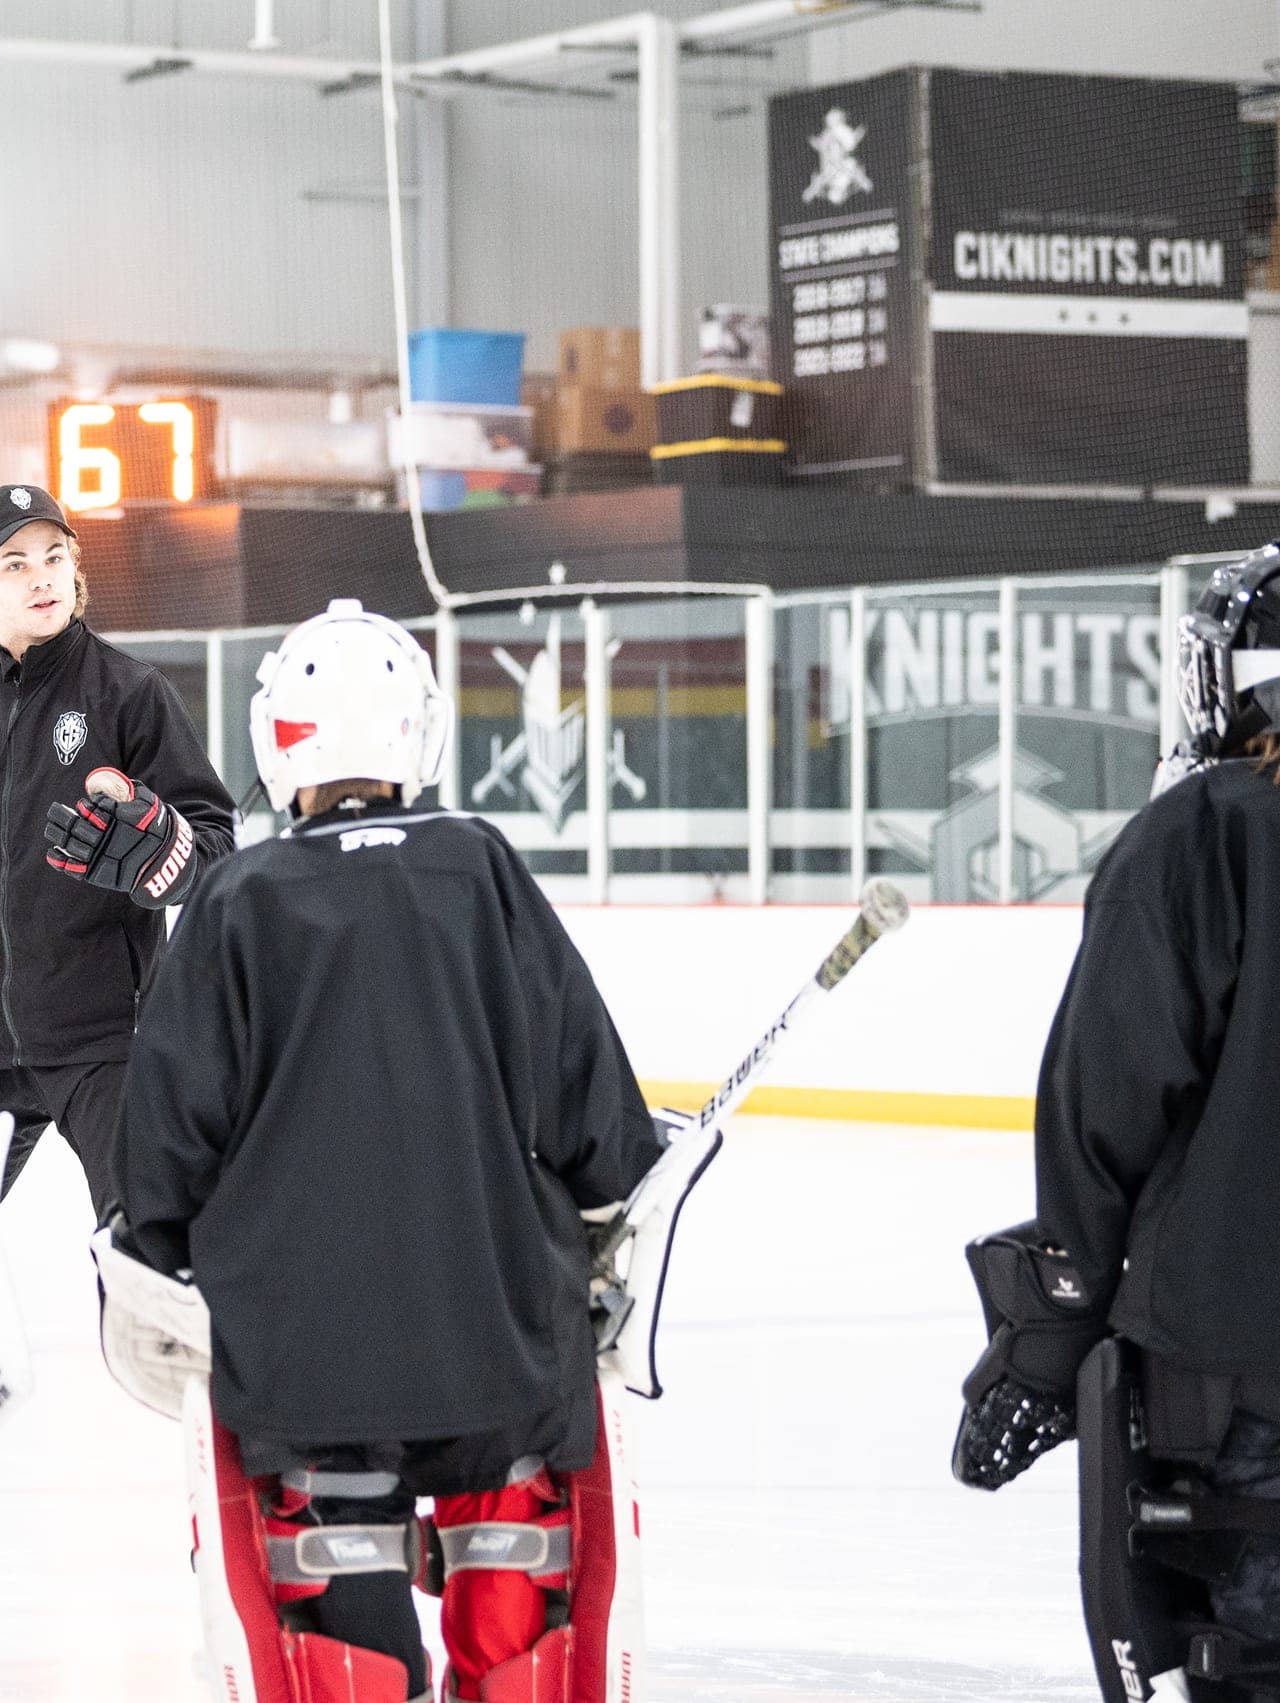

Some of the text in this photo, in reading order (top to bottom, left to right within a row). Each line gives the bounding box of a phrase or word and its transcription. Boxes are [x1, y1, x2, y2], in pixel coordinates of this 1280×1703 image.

[953, 229, 1225, 288] CIKNIGHTS.COM
[59, 402, 195, 512] 67
[828, 609, 1161, 722] KNIGHTS
[700, 1011, 787, 1129] BAUER
